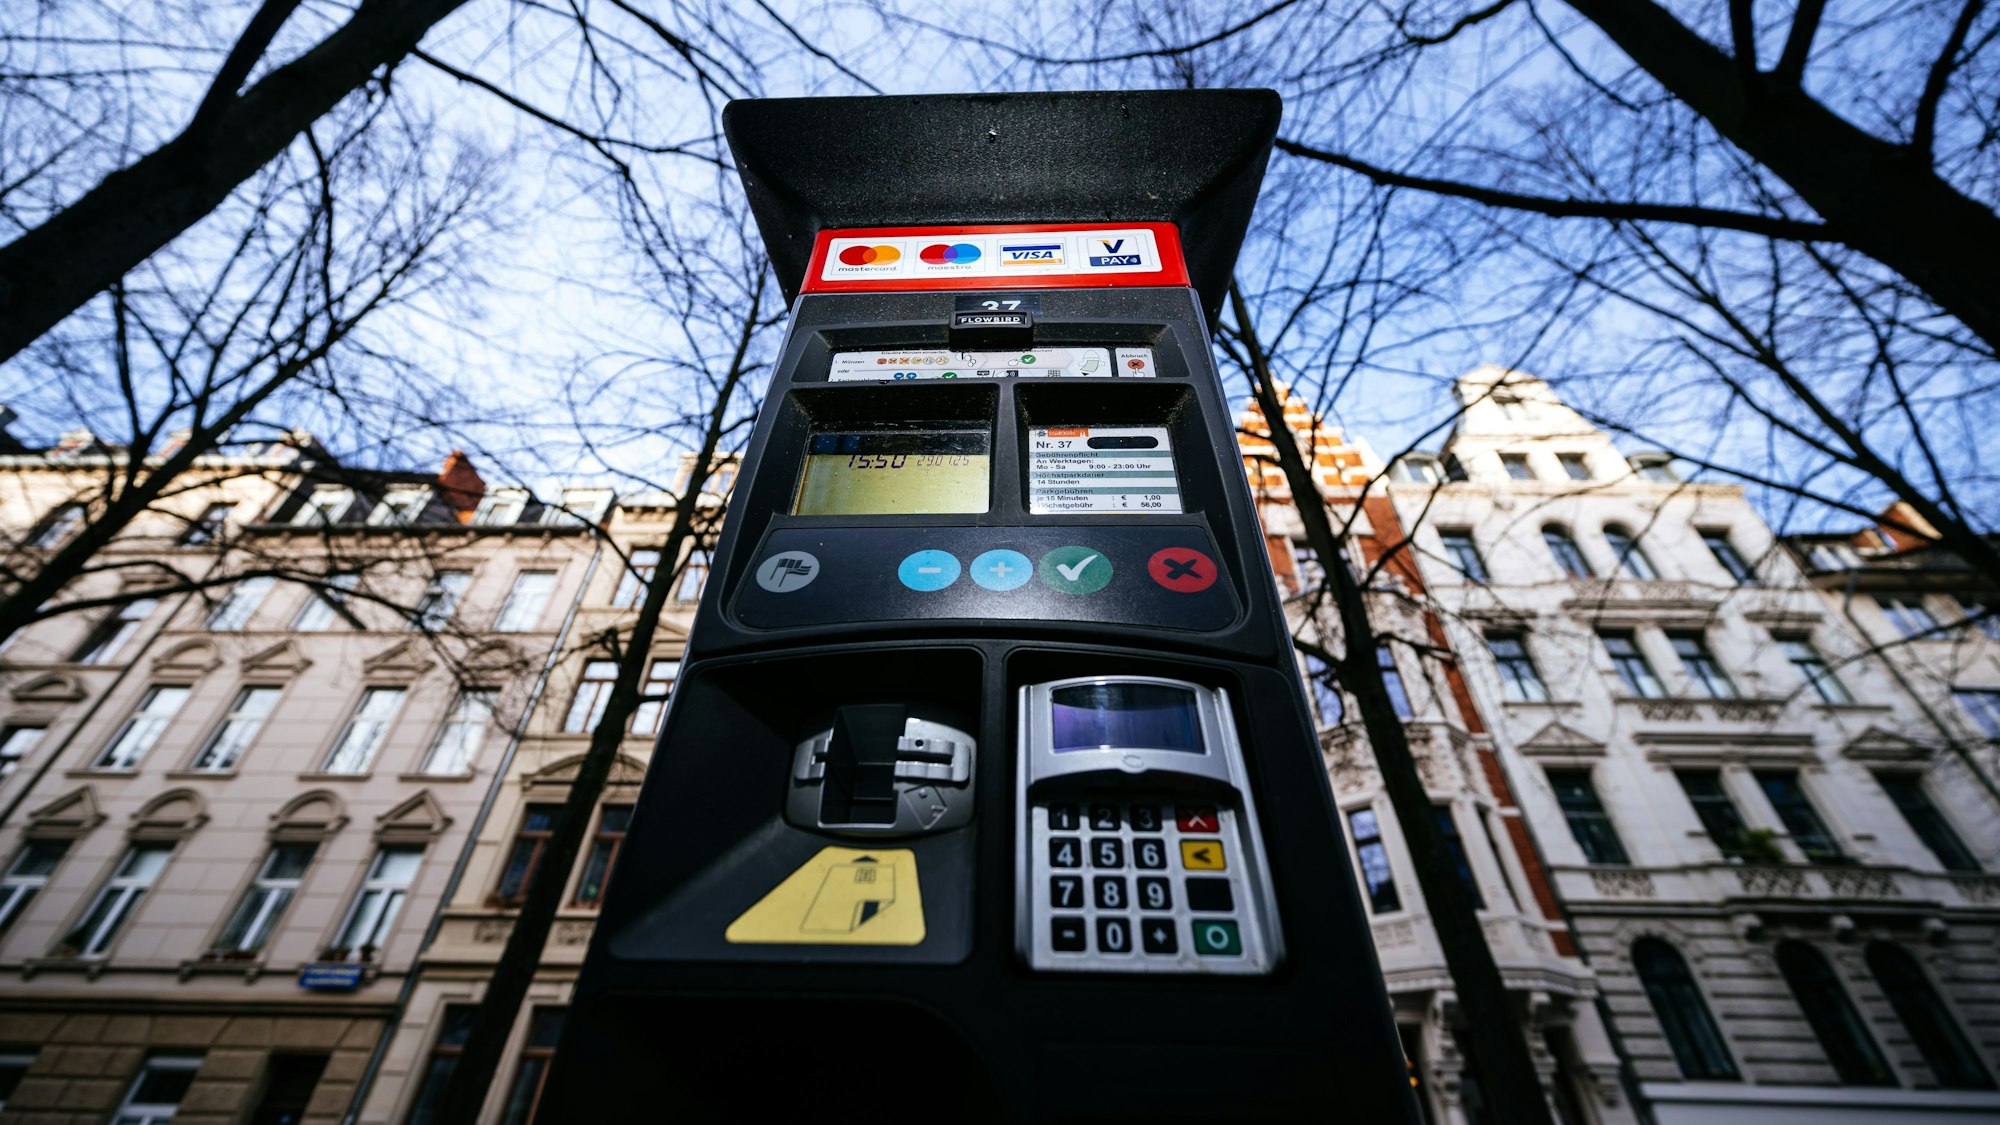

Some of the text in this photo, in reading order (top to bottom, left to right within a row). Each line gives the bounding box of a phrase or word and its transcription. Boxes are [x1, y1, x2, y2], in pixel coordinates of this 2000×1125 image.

[1012, 250, 1053, 260] VISA
[1101, 256, 1130, 265] PAY
[961, 316, 1021, 324] FLOWBIRD
[1036, 440, 1072, 449] Nr. 37
[848, 454, 907, 469] 15:50
[1097, 807, 1114, 829] 2
[1139, 807, 1154, 829] 3
[1057, 843, 1075, 866] 4
[1100, 842, 1117, 866] 5
[1142, 843, 1160, 867] 6
[1058, 880, 1075, 906] 7
[1103, 881, 1120, 907] 8
[1146, 882, 1165, 908] 9
[1105, 922, 1124, 950] 0
